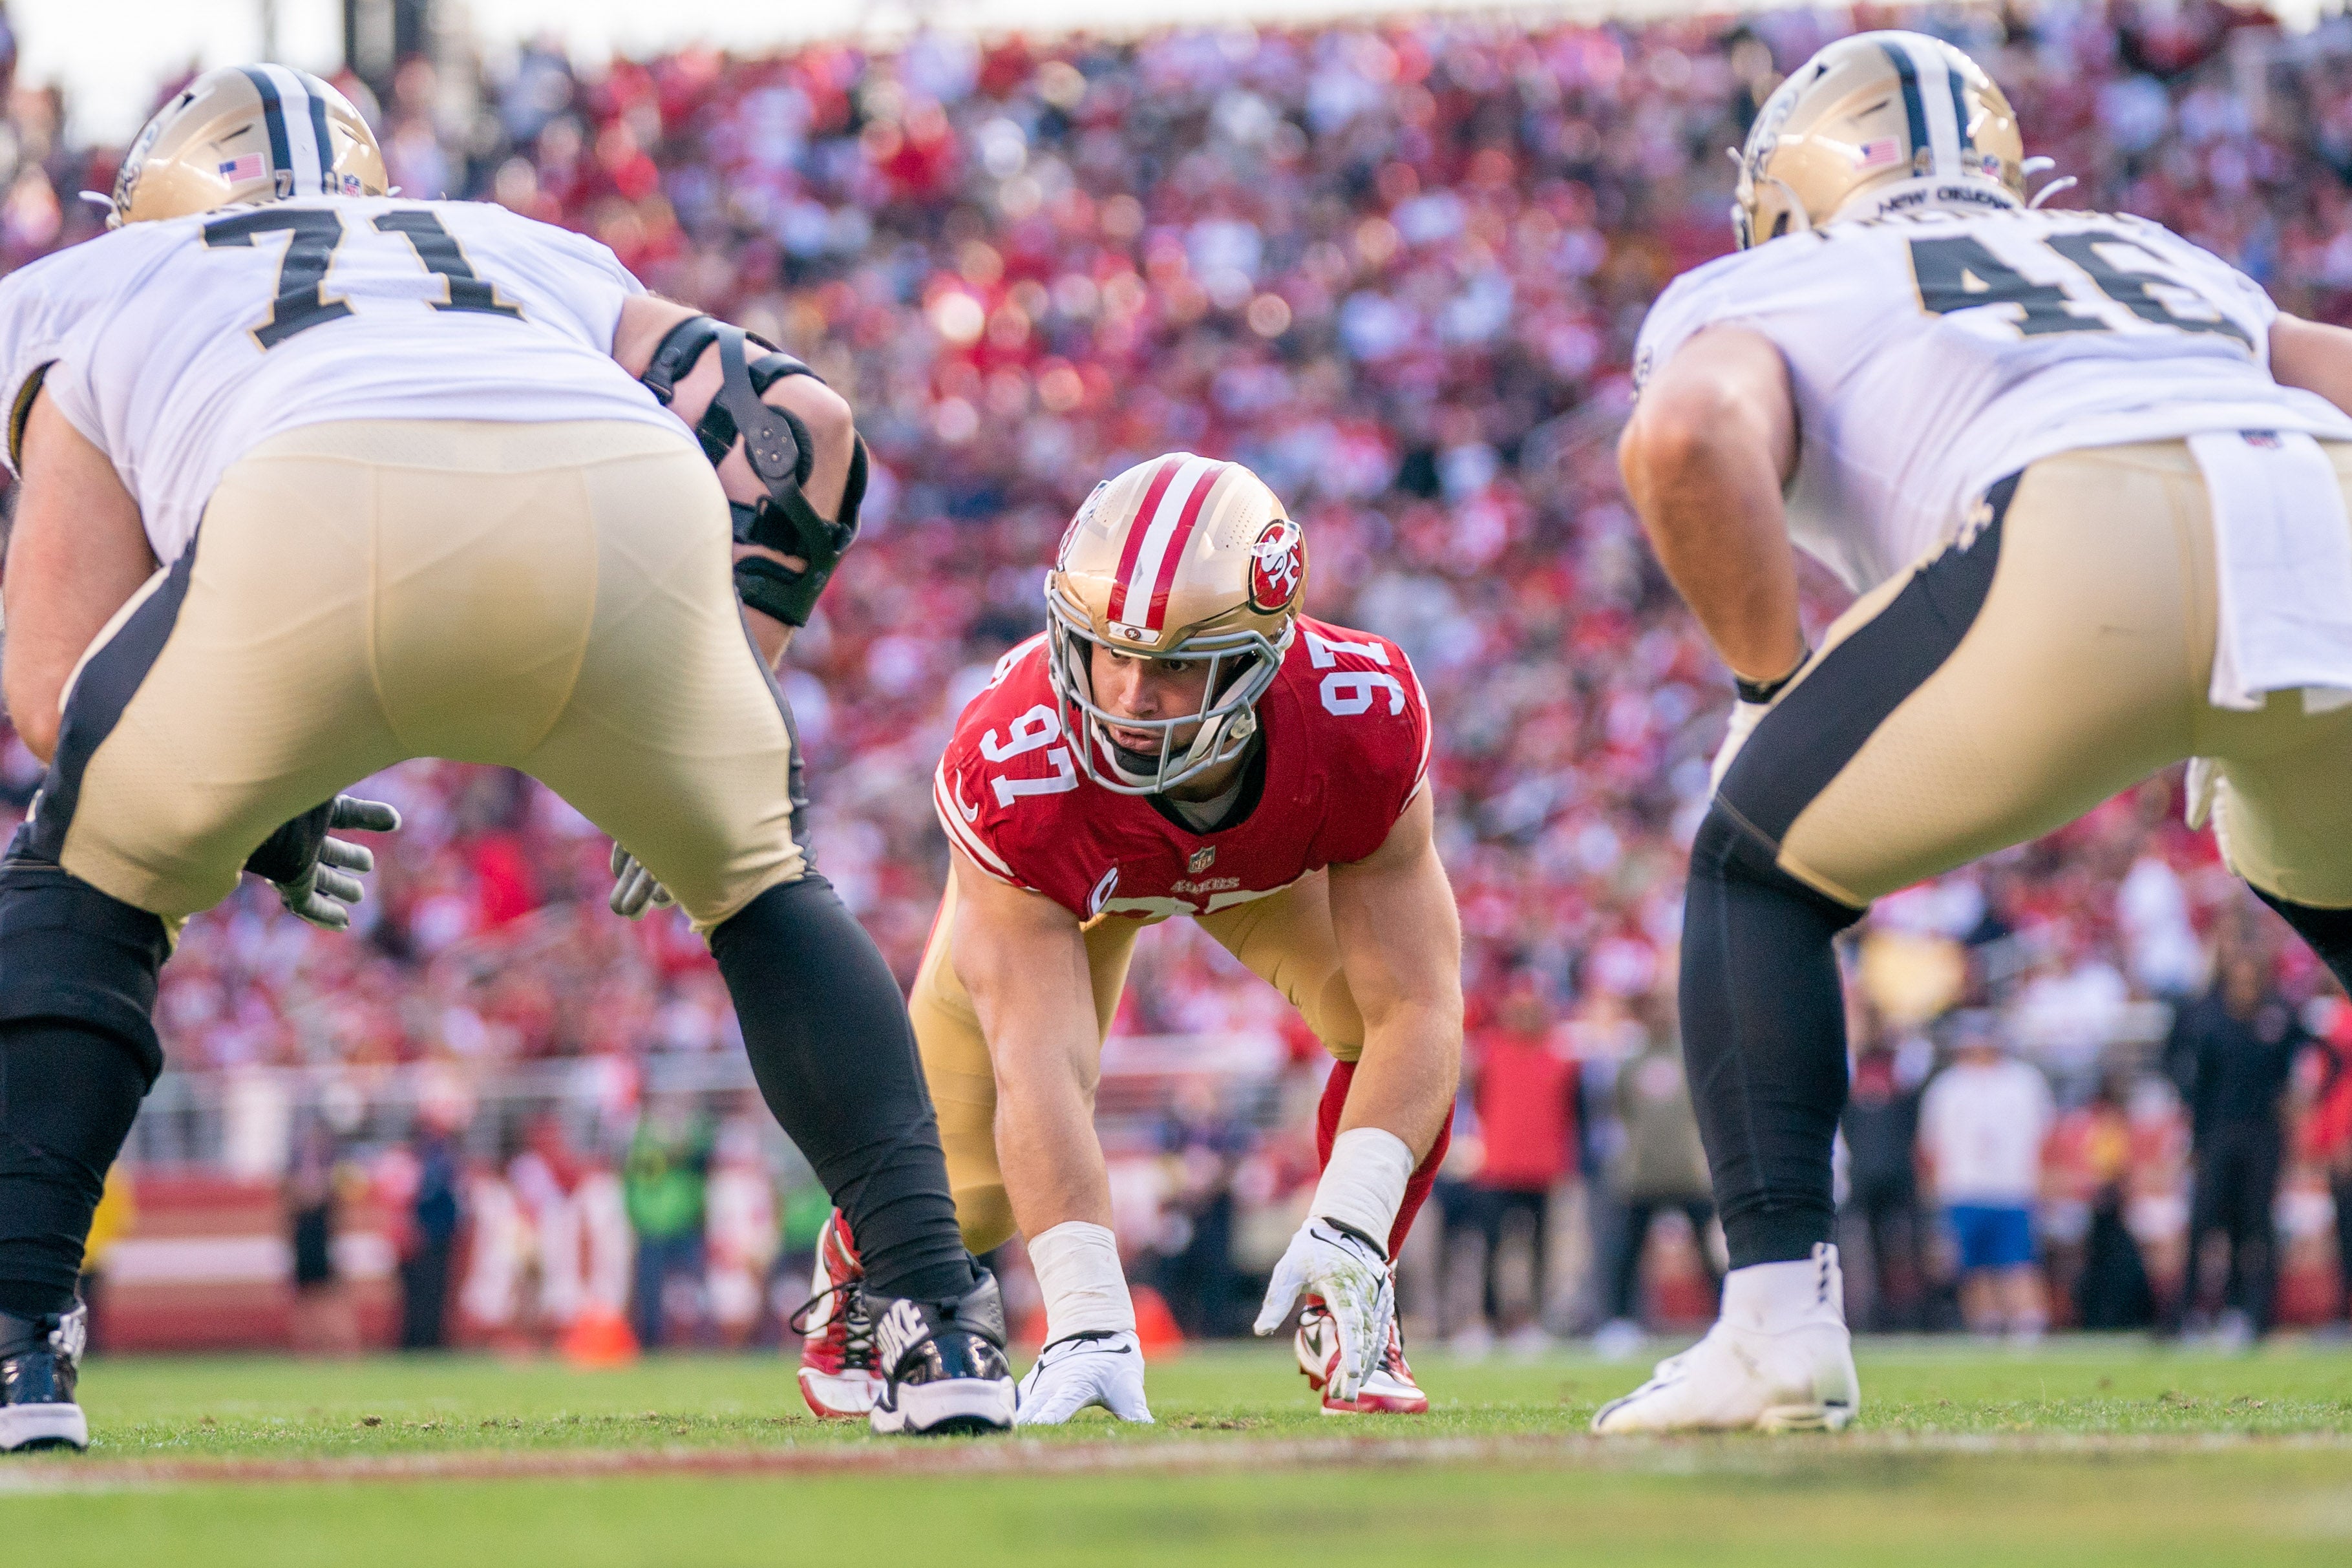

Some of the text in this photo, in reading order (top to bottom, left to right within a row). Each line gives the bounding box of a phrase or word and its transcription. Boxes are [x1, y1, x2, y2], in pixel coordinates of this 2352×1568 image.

[1878, 188, 1927, 214] NEW
[200, 207, 528, 353] 71
[1905, 231, 2257, 358] 46
[1303, 631, 1406, 716] 97
[979, 704, 1079, 809] 97
[1170, 876, 1240, 895] 49ERS
[1191, 855, 1213, 871] NFL
[876, 1298, 929, 1375] NIKE
